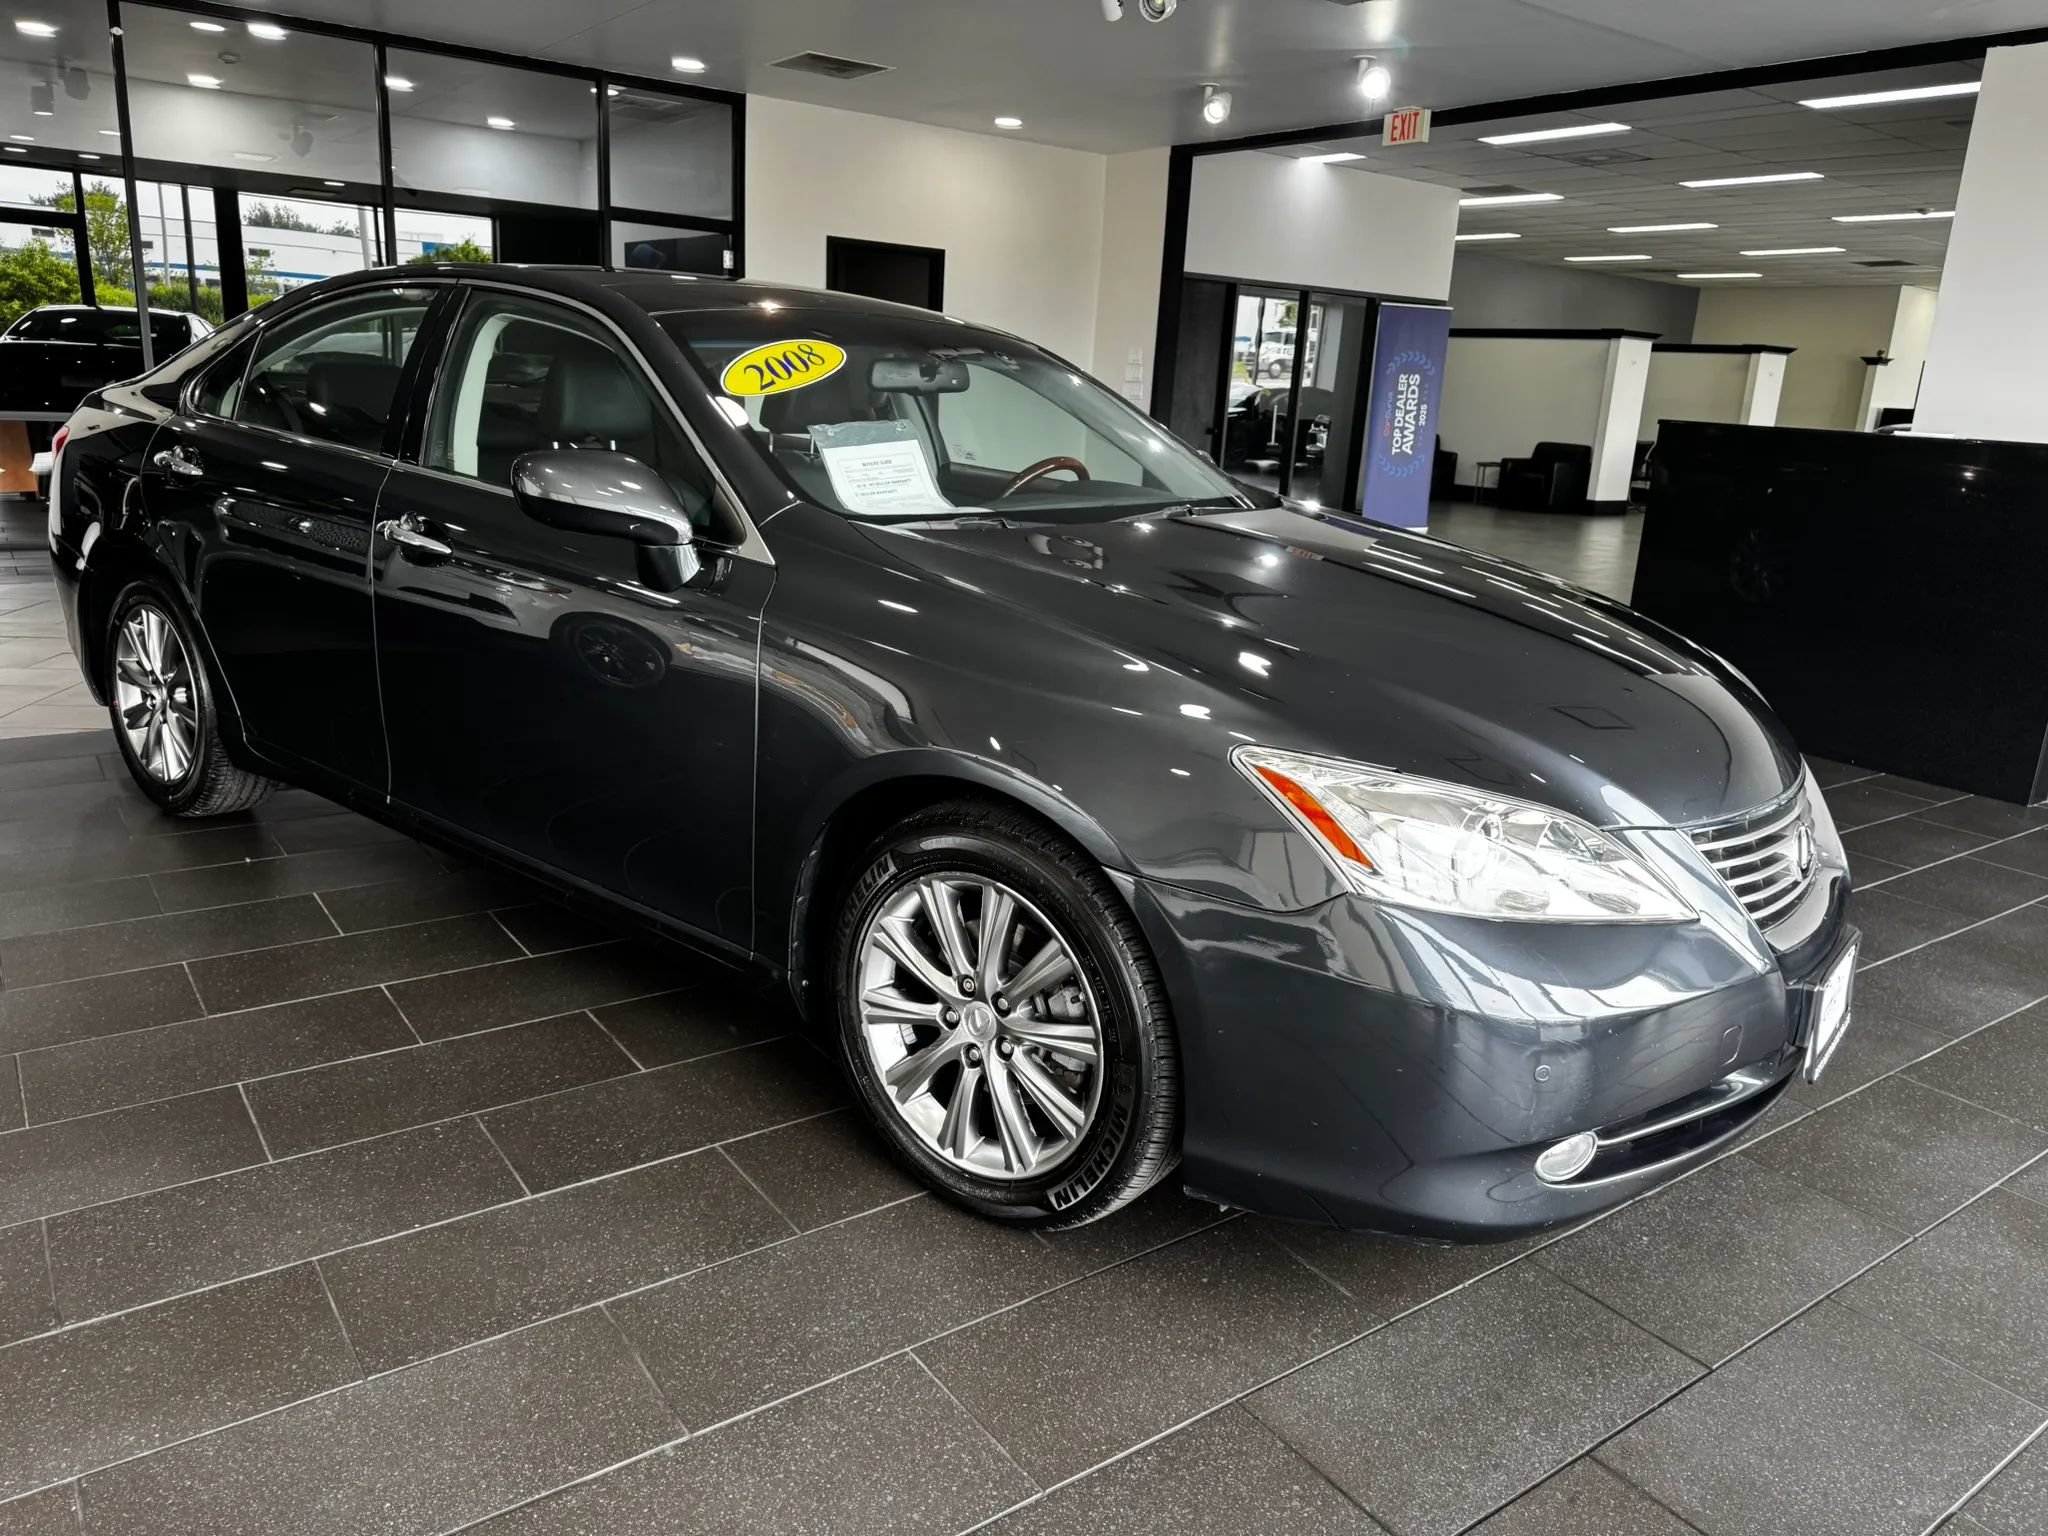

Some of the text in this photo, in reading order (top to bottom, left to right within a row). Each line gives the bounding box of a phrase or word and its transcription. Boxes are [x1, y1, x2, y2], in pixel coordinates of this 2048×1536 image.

[1391, 111, 1420, 142] EXIT
[744, 343, 825, 391] 2008
[1392, 373, 1408, 455] TOP DEALER
[1402, 373, 1420, 455] AWARDS
[1053, 1102, 1129, 1209] MICHELIN
